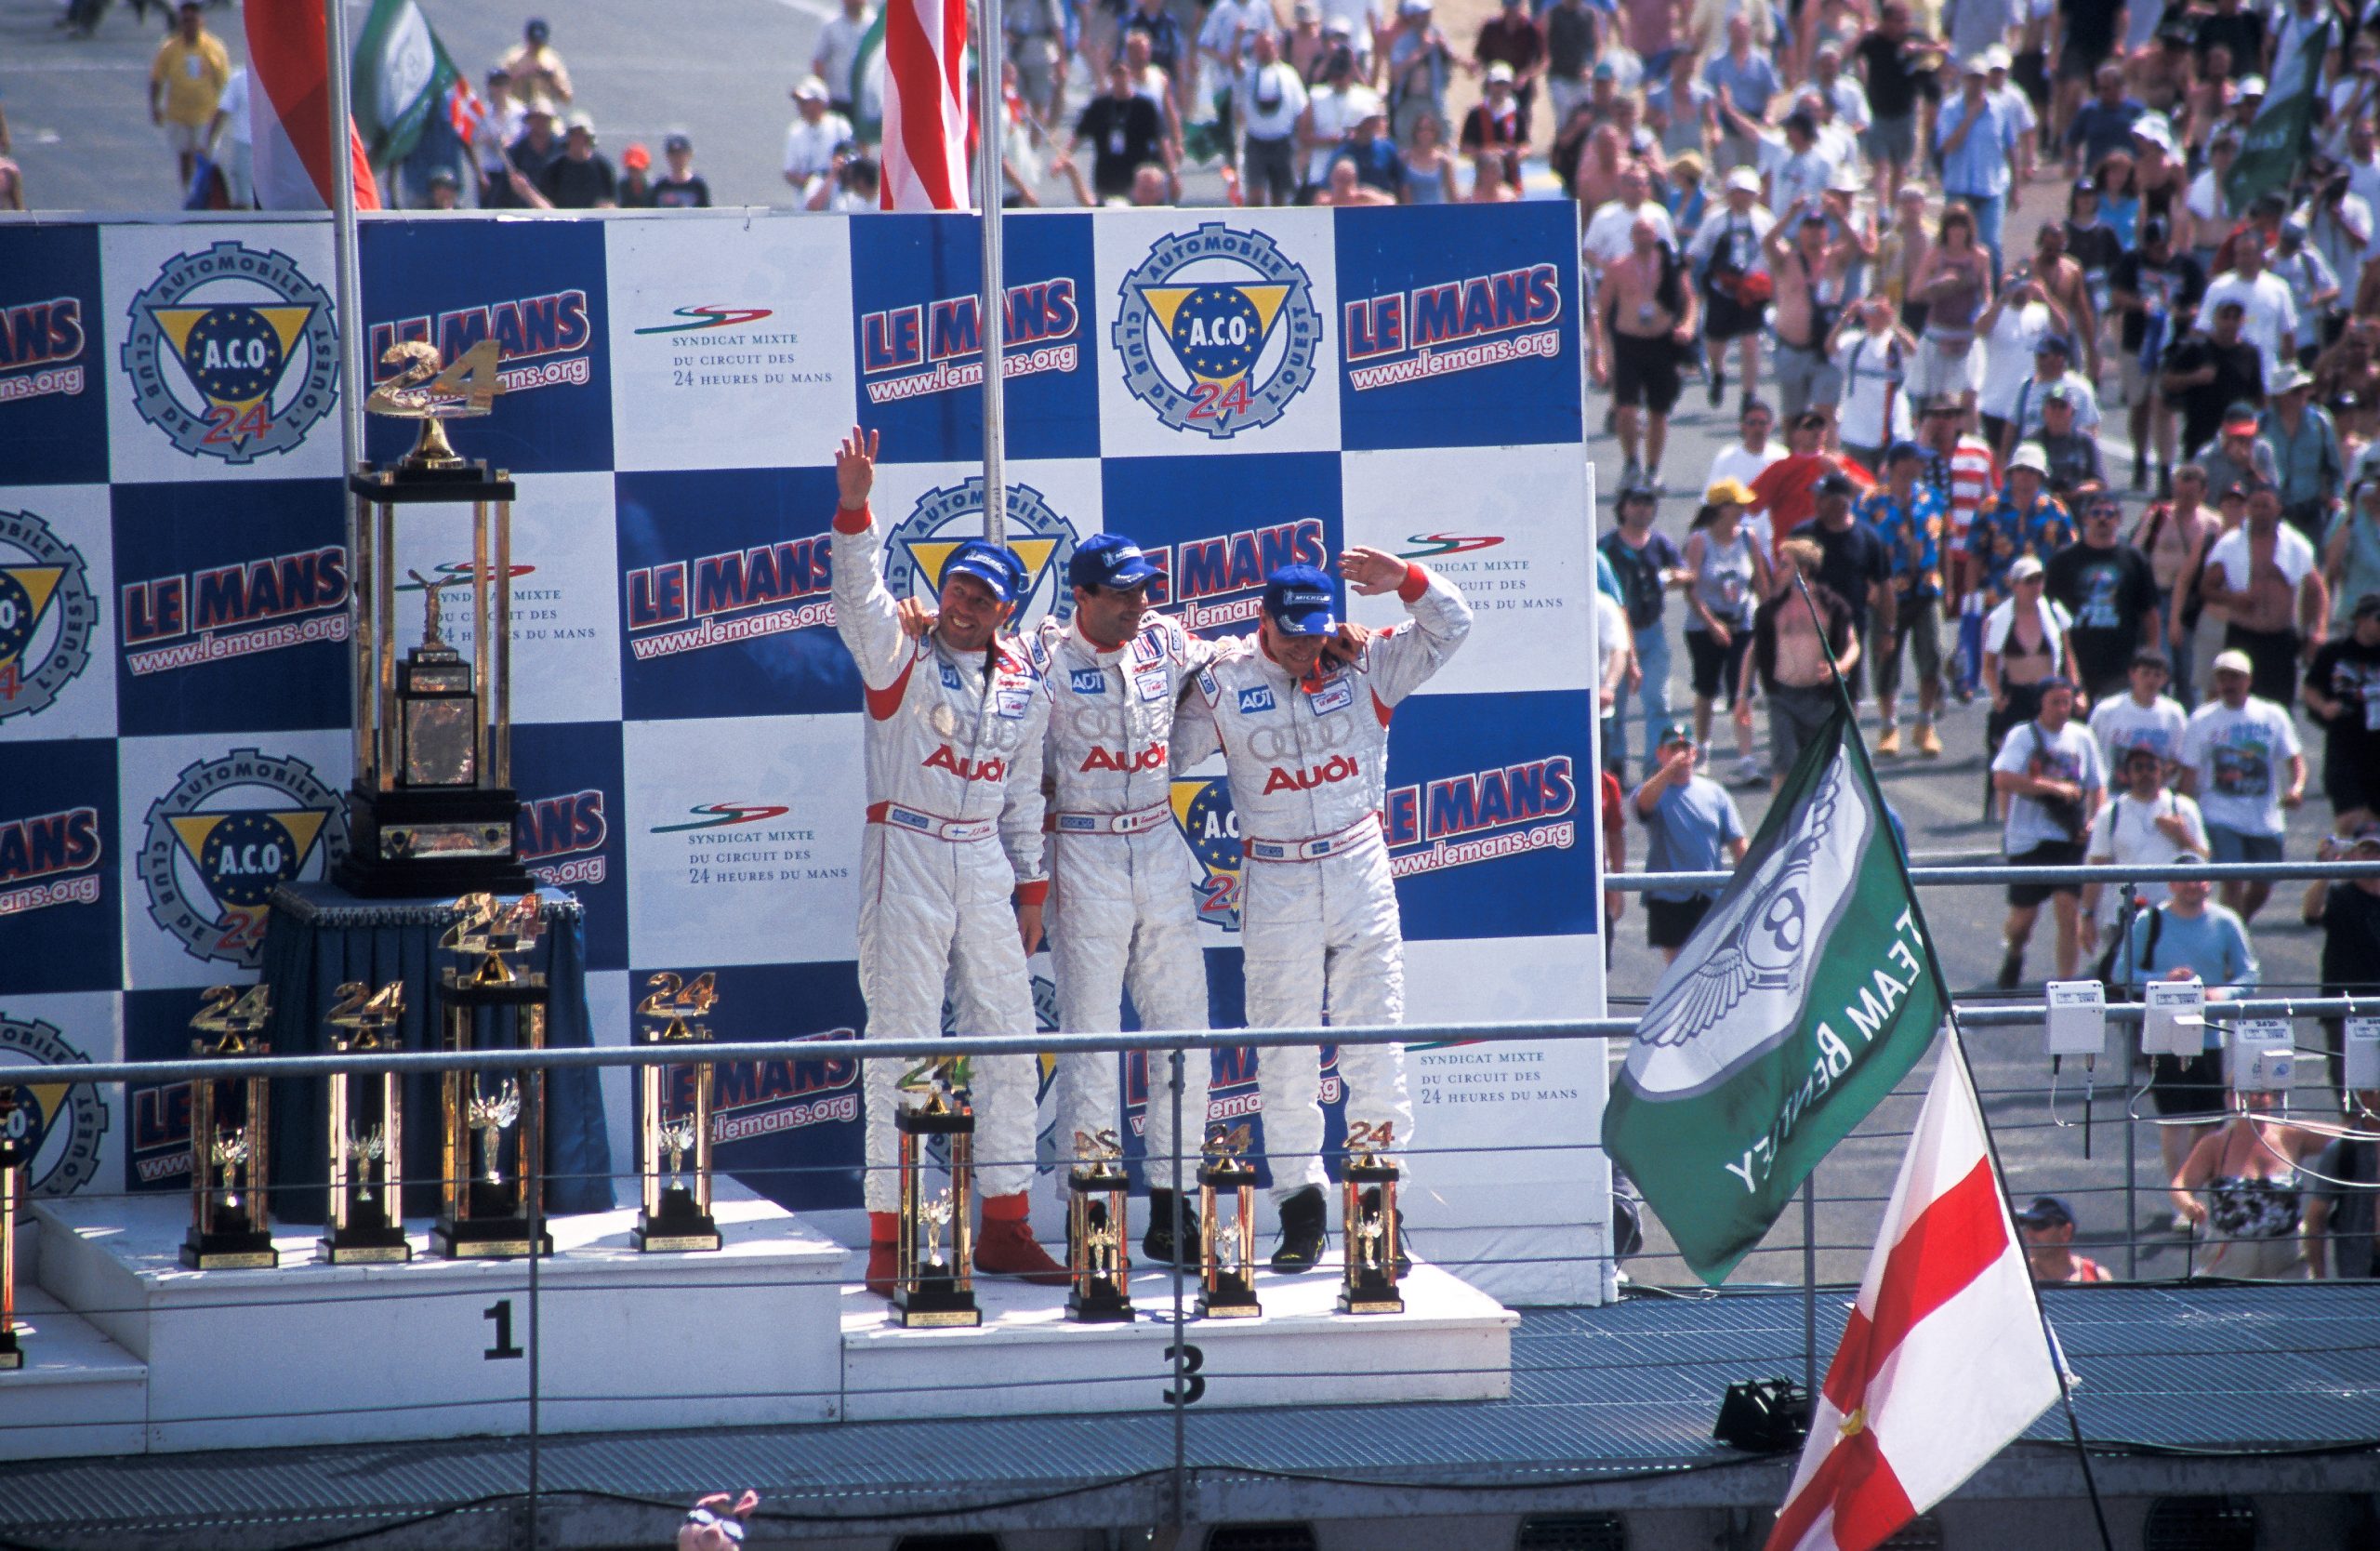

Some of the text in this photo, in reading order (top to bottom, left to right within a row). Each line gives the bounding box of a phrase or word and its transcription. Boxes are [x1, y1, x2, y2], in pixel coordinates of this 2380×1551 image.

[159, 255, 303, 299] AUTOMOBILE
[1148, 236, 1283, 279] AUTOMOBILE
[437, 289, 589, 374] MANS
[1189, 316, 1248, 347] A.C.O
[1345, 262, 1561, 363] LE MANS
[204, 338, 266, 369] A.C.O
[672, 334, 799, 347] SYNDICAT MIXTE
[674, 353, 795, 366] DU CIRCUIT DES
[862, 304, 923, 375] LE
[1126, 307, 1309, 411] CLUB DE L'OUEST
[1349, 329, 1560, 391] www.lemans.org
[137, 328, 333, 435] CLUB DE L'OUEST
[363, 339, 506, 418] 24
[673, 370, 833, 386] 24 HEURES DU MANS
[866, 343, 1078, 404] www.lemns.org
[1185, 377, 1255, 422] 24
[201, 403, 273, 445] 24
[914, 490, 1051, 535] AUTOMBILE
[0, 521, 55, 558] BILE
[1177, 518, 1327, 603] MANS
[627, 532, 832, 631] LE MANS
[1429, 560, 1529, 573] DICAT MIXTE
[1454, 579, 1527, 591] CUIT DES
[123, 545, 348, 646] LE MANS
[514, 590, 562, 601] MIXTE
[530, 610, 558, 620] DES
[1467, 598, 1564, 611] RES DU MANS
[35, 589, 84, 690] L'OUEST
[126, 613, 348, 676] www.lemans.org
[526, 630, 546, 640] DU
[553, 628, 596, 639] MANS
[631, 601, 837, 660] www.lemans.org
[1072, 673, 1104, 692] ADT
[1240, 691, 1273, 710] ADT
[177, 762, 320, 807] AUTOMOBILE
[1382, 754, 1576, 850] E MANS
[516, 789, 606, 863] ANS
[688, 830, 815, 845] SYNDICAT MIXTE
[1204, 810, 1239, 839] A.C
[218, 843, 279, 875] A.C.O
[690, 850, 812, 865] DU CIRCUIT DES
[1388, 821, 1574, 878] ww.lemans.org
[152, 841, 203, 941] CLUB DE
[689, 868, 848, 884] 24 HEURES DU MANS
[190, 984, 273, 1031] 24
[324, 980, 407, 1027] 24
[636, 971, 719, 1017] 24
[1420, 1052, 1545, 1066] SYNDICAT MIXTE
[1422, 1071, 1541, 1084] DU CIRCUIT DES
[1421, 1089, 1578, 1104] 24 HEURES DU MANS
[710, 1094, 857, 1146] .lemans.org
[1200, 1123, 1253, 1156] 24
[1342, 1120, 1395, 1152] 24
[483, 1299, 523, 1360] 1
[1163, 1345, 1205, 1405] 3
